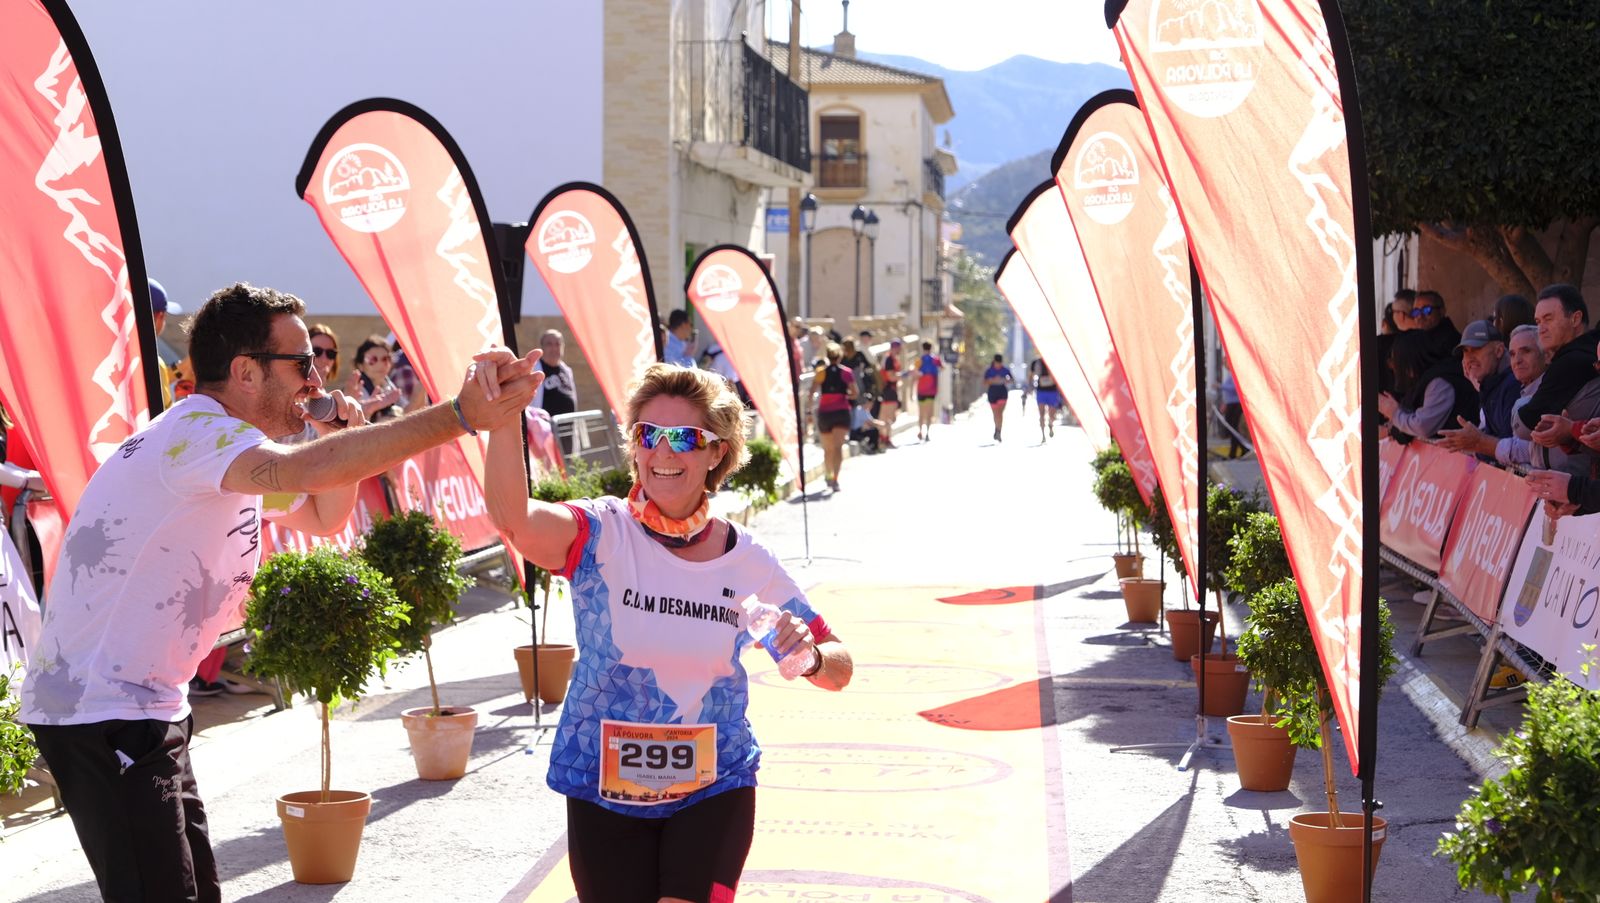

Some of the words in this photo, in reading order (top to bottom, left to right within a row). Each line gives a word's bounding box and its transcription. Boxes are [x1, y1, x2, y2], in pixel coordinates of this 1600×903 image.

[432, 476, 487, 521] VEOLIA
[1405, 481, 1452, 539] VEOLIA
[1469, 509, 1518, 582] VEOLIA
[1544, 566, 1600, 639] CANTO
[621, 743, 694, 770] 299
[741, 888, 872, 903] POLV
